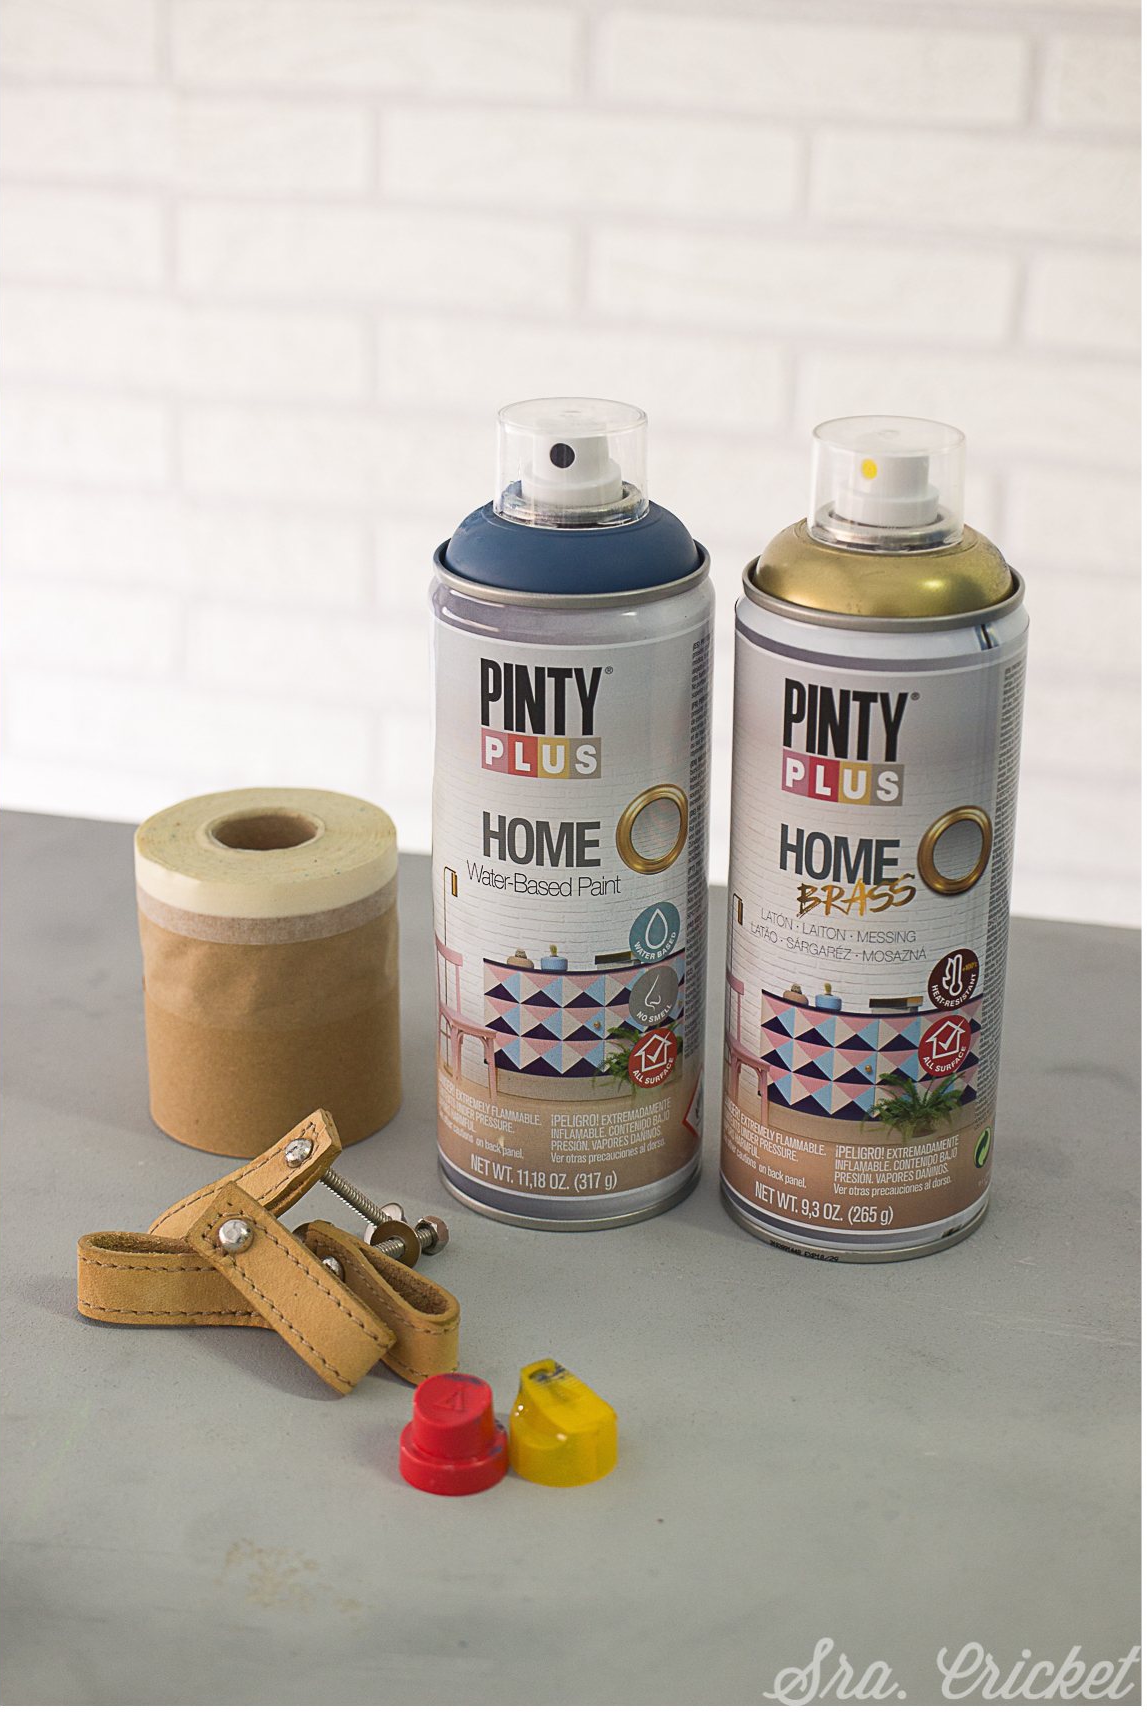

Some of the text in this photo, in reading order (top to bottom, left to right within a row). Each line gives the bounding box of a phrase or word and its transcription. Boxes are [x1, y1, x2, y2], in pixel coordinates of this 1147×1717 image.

[480, 657, 603, 736] PINTY
[782, 677, 909, 762] PINTY
[484, 734, 598, 775] PLUS
[784, 757, 900, 802] PLUS
[482, 810, 601, 868] HOME
[779, 822, 901, 886] HOME
[466, 859, 621, 898] Water-Based Paint
[796, 873, 917, 918] BRASS
[760, 907, 917, 944] LATÓN LAITON MESSING
[634, 931, 677, 960] WATER BASED
[861, 946, 926, 963] MOSAZNÁ
[636, 1004, 673, 1023] NO SMELL
[632, 1057, 674, 1085] ALL SURFACE
[922, 1046, 967, 1072] ALL SURFACE
[455, 1088, 490, 1114] EXTREMELY
[491, 1105, 543, 1126] FLAMMABLE.
[550, 1097, 672, 1128] ¡PELIGRO! EXTREMADAMENTE
[475, 1111, 515, 1134] PRESSURE.
[550, 1110, 671, 1140] INFLAMABLE. CONTENIDO BAJO
[740, 1112, 775, 1141] EXTREMELY
[775, 1132, 827, 1156] FLAMMABLE.
[484, 1139, 501, 1154] back
[502, 1147, 525, 1159] panel.
[550, 1152, 565, 1163] Ver
[566, 1153, 587, 1164] otras
[588, 1147, 639, 1165] precauciones
[639, 1143, 646, 1154] al
[591, 1135, 629, 1151] VAPORES
[740, 1124, 759, 1146] UNDER
[759, 1137, 799, 1162] PRESSURE.
[835, 1134, 960, 1160] ¡PELIGRO! EXTREMADAMENTE
[470, 1153, 618, 1193] NET WT. 11,18 OZ. (317 g)
[834, 1147, 958, 1172] INFLAMABLE. CONTENIDO BAJO
[758, 1163, 767, 1175] on
[767, 1166, 784, 1181] back
[784, 1175, 807, 1189] panel.
[833, 1169, 874, 1184] PRESIÓN.
[876, 1170, 914, 1183] VAPORES
[833, 1175, 952, 1198] Ver otras precauciones al dorso.
[755, 1180, 894, 1226] NET WT. 9,3 OZ. (265 g)
